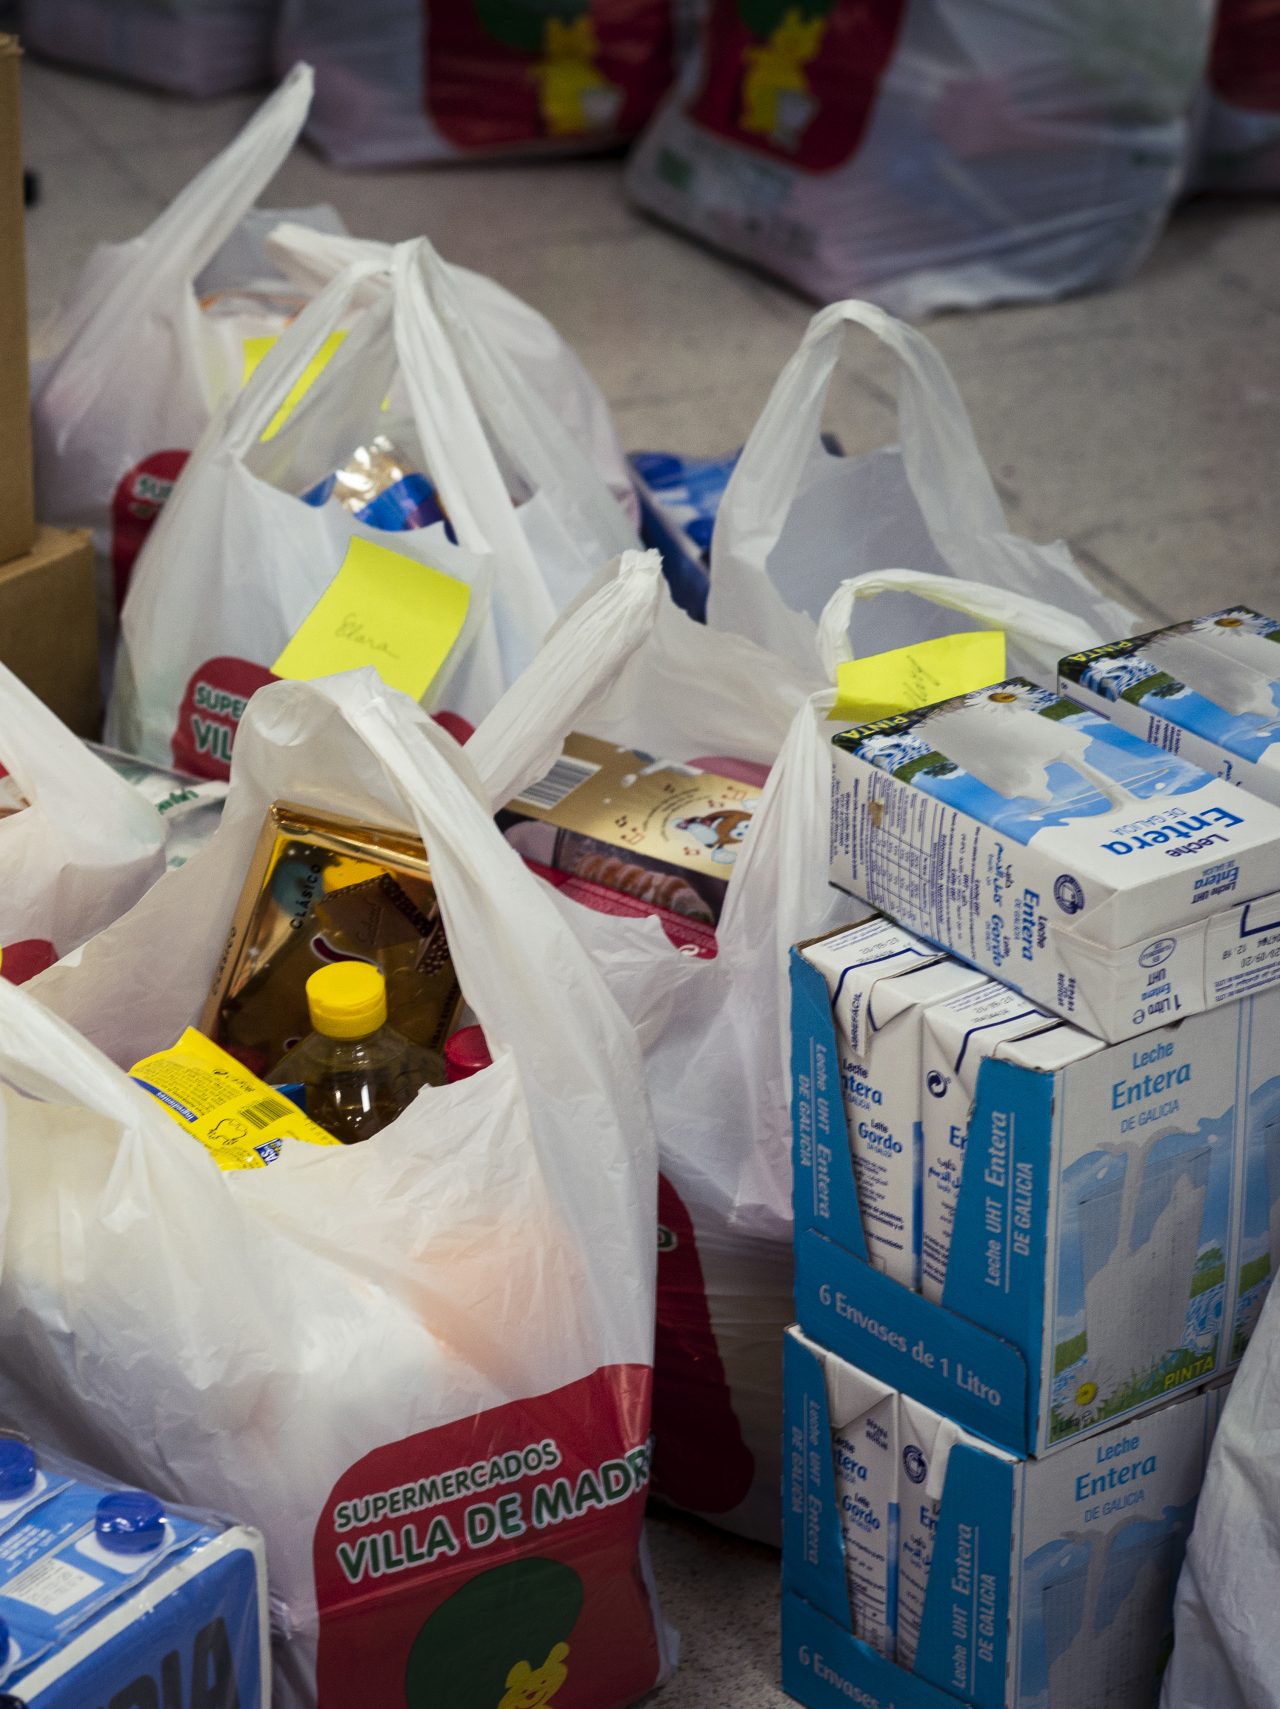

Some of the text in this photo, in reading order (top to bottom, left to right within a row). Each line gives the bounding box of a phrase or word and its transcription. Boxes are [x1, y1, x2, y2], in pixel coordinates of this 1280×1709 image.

[1068, 639, 1133, 663] PINTA
[840, 715, 909, 740] PINTA
[1101, 806, 1246, 856] Entera
[1164, 833, 1230, 858] Leche
[289, 862, 322, 931] CLÁSICO
[1193, 866, 1241, 891] Entera
[991, 913, 1005, 968] Gordo
[1022, 888, 1040, 961] Entera
[1036, 915, 1049, 949] Leche
[1147, 968, 1167, 987] UHT
[1147, 997, 1172, 1016] Litro
[842, 1058, 869, 1079] Leche
[1131, 1040, 1175, 1071] Leche
[157, 1089, 198, 1122] Ingredientes
[841, 1074, 883, 1106] ntera
[1110, 1062, 1192, 1112] Entera
[798, 1073, 812, 1168] DE GALICIA
[815, 1043, 833, 1219] Leche UHT Entera
[1120, 1098, 1181, 1135] DE GALICIA
[858, 1121, 903, 1155] Gordo
[984, 1109, 1010, 1288] Leche UHT Entera
[1013, 1162, 1034, 1257] DE GALICIA
[819, 1284, 1003, 1407] 6 Envases de 1 Litro
[1163, 1354, 1216, 1391] PINTA
[1096, 1434, 1141, 1465] Leche
[335, 1440, 561, 1532] SUPERMERCADOS
[790, 1452, 803, 1513] GALICIA
[1074, 1452, 1157, 1502] Entera
[842, 1494, 881, 1530] Gordo
[1084, 1488, 1145, 1522] DE GALICIA
[337, 1515, 458, 1583] VILLA
[465, 1495, 524, 1547] DE
[807, 1494, 823, 1565] Entera
[951, 1523, 974, 1689] Leche UHT Entera
[977, 1572, 997, 1663] DE GALICIA
[798, 1645, 810, 1667] 6
